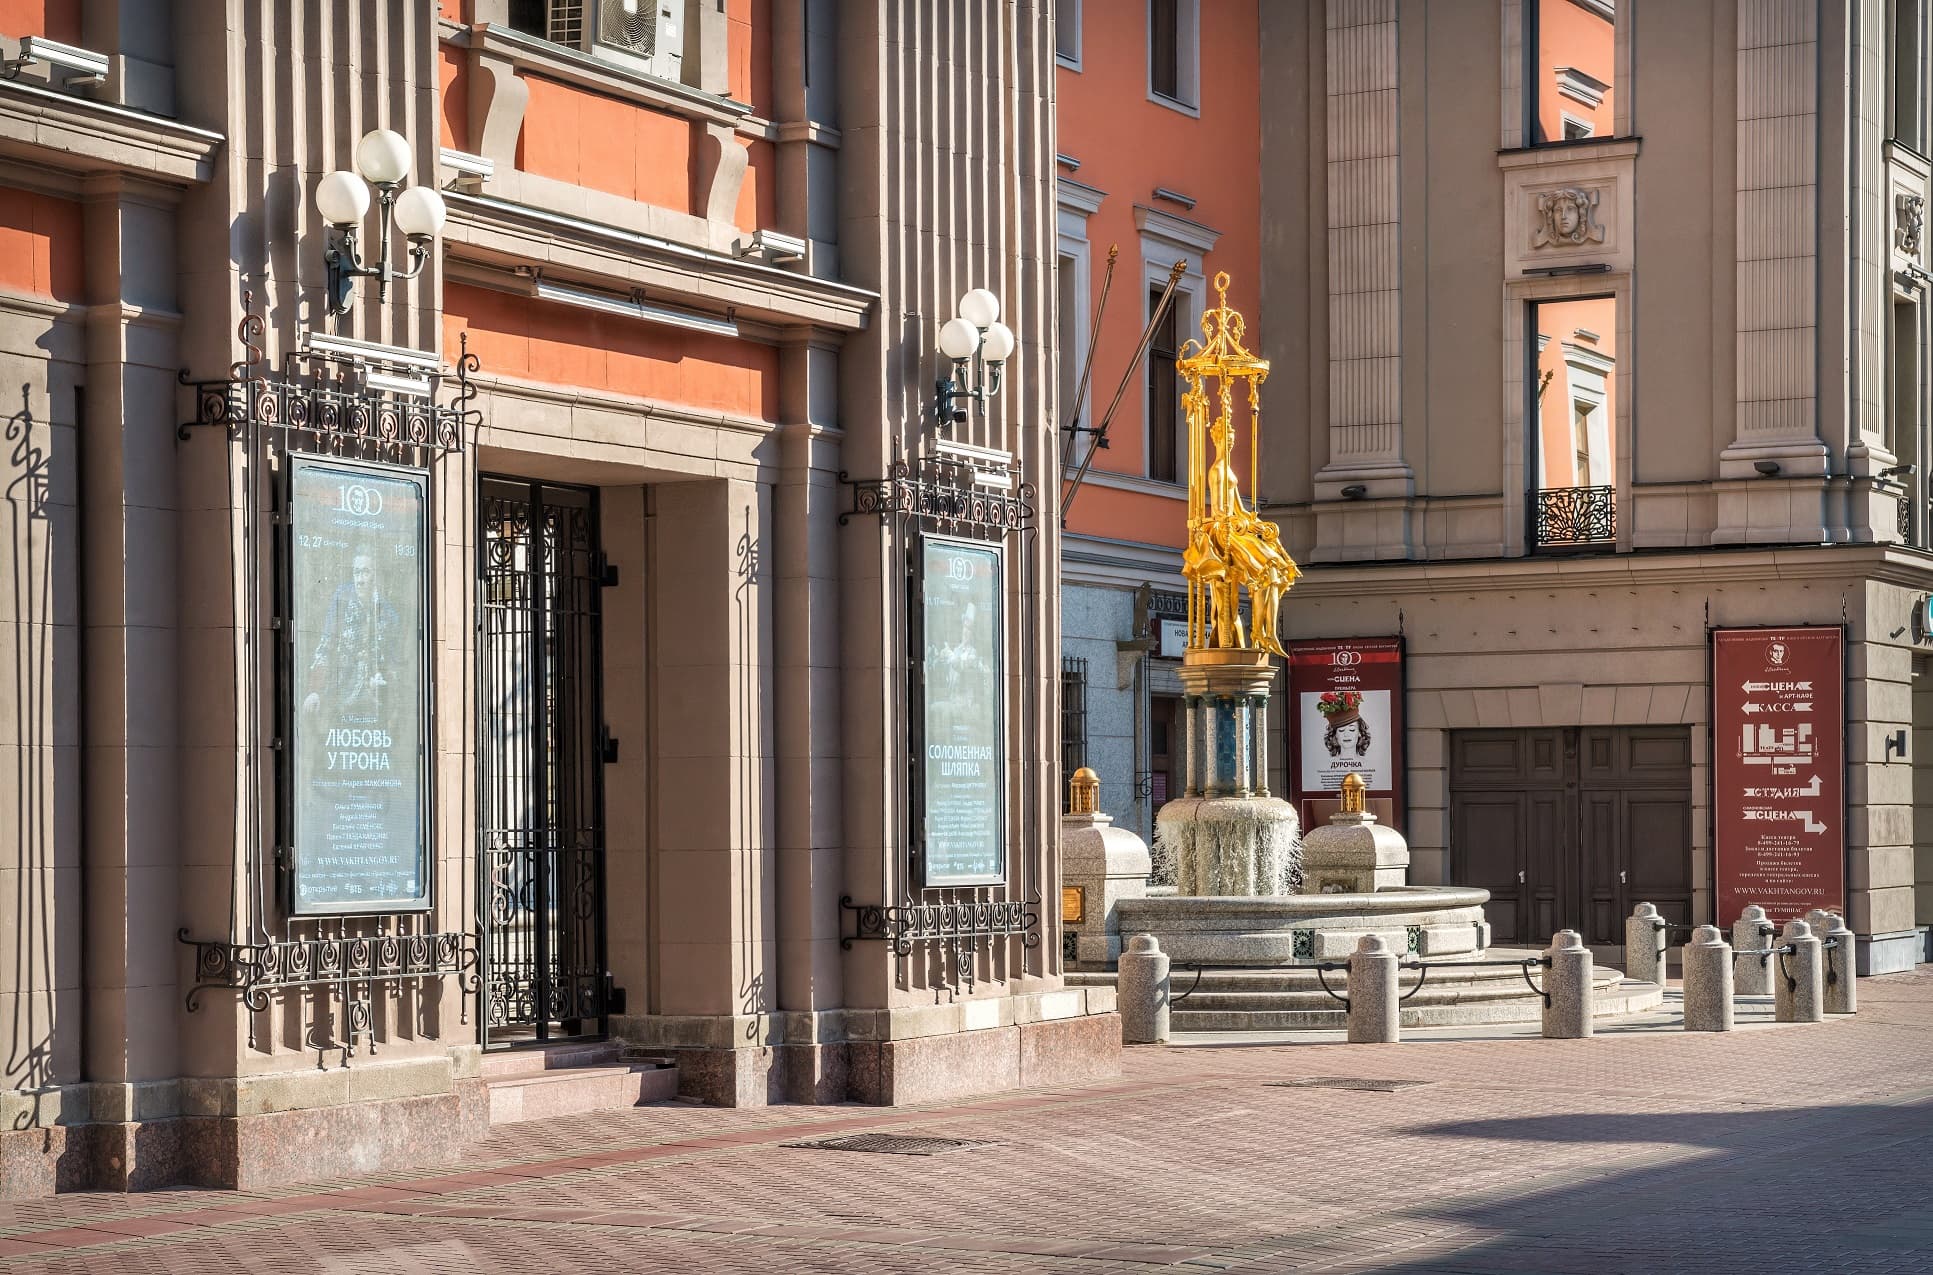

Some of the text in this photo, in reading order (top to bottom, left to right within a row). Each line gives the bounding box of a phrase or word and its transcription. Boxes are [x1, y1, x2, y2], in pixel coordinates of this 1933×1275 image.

[332, 484, 383, 516] 100
[1327, 651, 1362, 666] 100
[1334, 675, 1361, 683] СЦЕНА
[1759, 703, 1796, 712] КАССА
[325, 729, 392, 748] ЛЮБОВЬ
[928, 745, 992, 760] СОЛОМЕННАЯ
[327, 752, 390, 770] У ТРОНА
[1330, 761, 1363, 769] ДУРОЧКА
[941, 761, 980, 776] ШЛЯПКА
[1754, 788, 1800, 799] СТУДИЯ
[1756, 811, 1796, 822] СЦЕНА
[1734, 887, 1825, 895] WWW.VAKHTANGOV.RU
